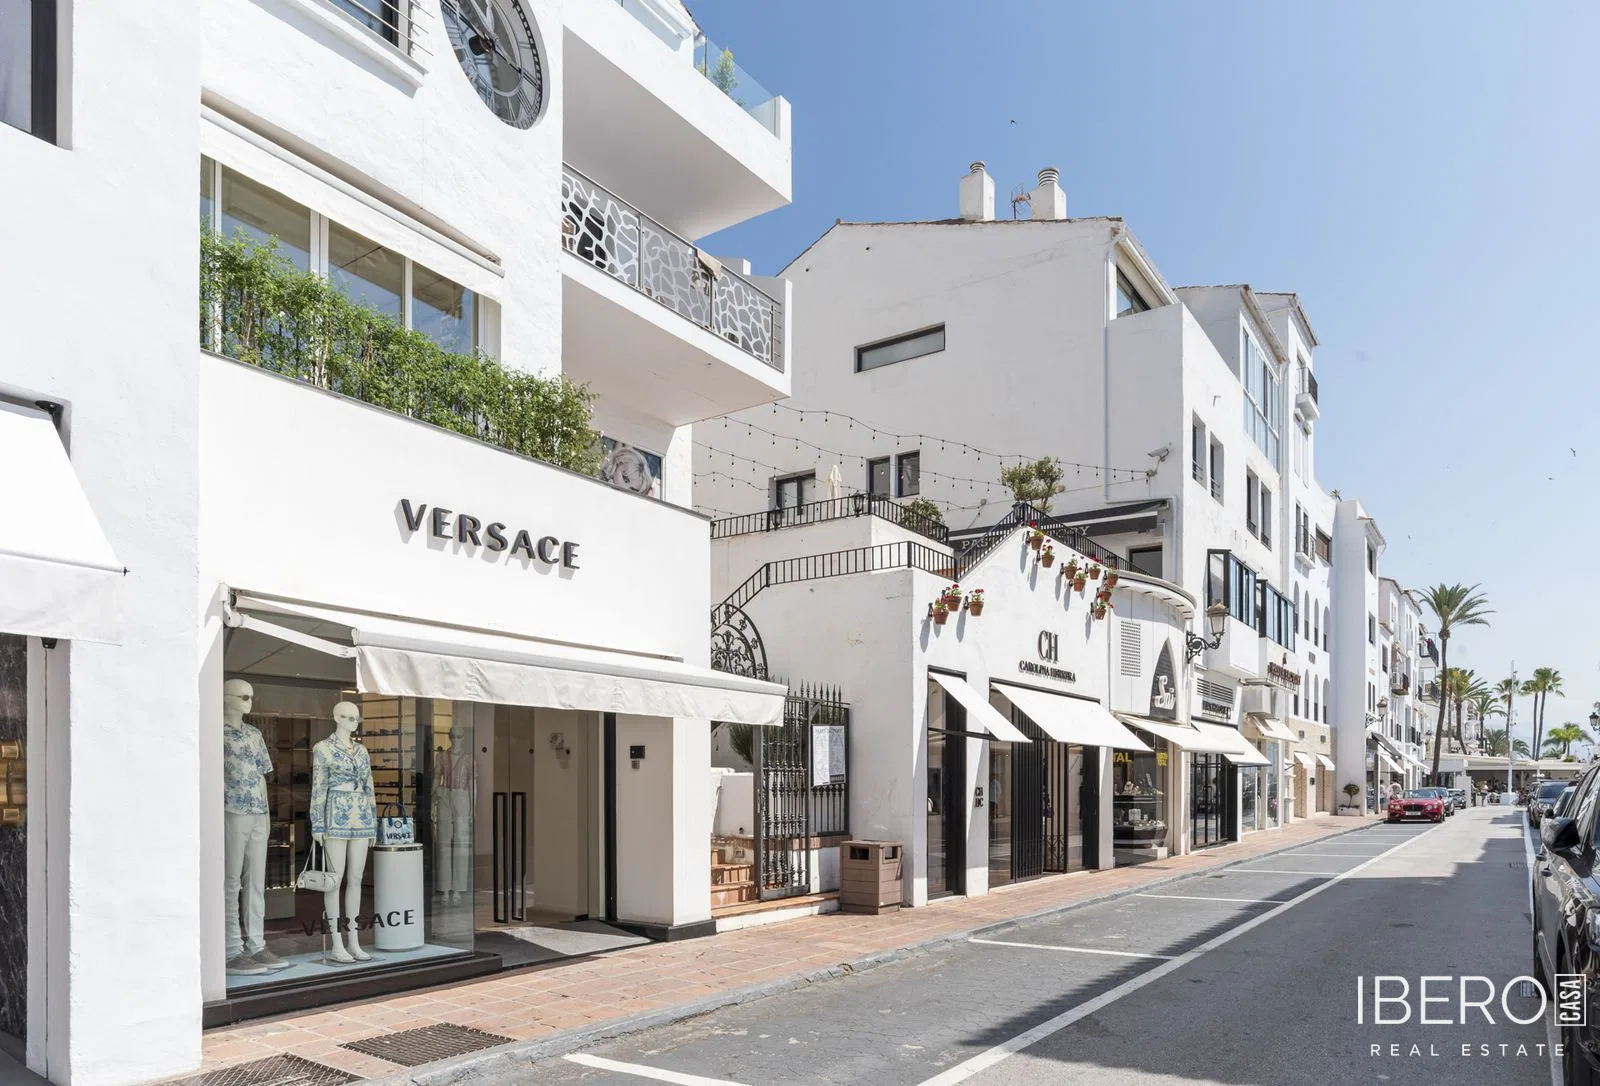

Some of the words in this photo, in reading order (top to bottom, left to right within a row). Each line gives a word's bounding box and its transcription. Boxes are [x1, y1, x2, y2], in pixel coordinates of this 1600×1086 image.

[400, 498, 581, 570] VERSACE
[1038, 629, 1059, 662] CH
[302, 909, 415, 936] VERSACE
